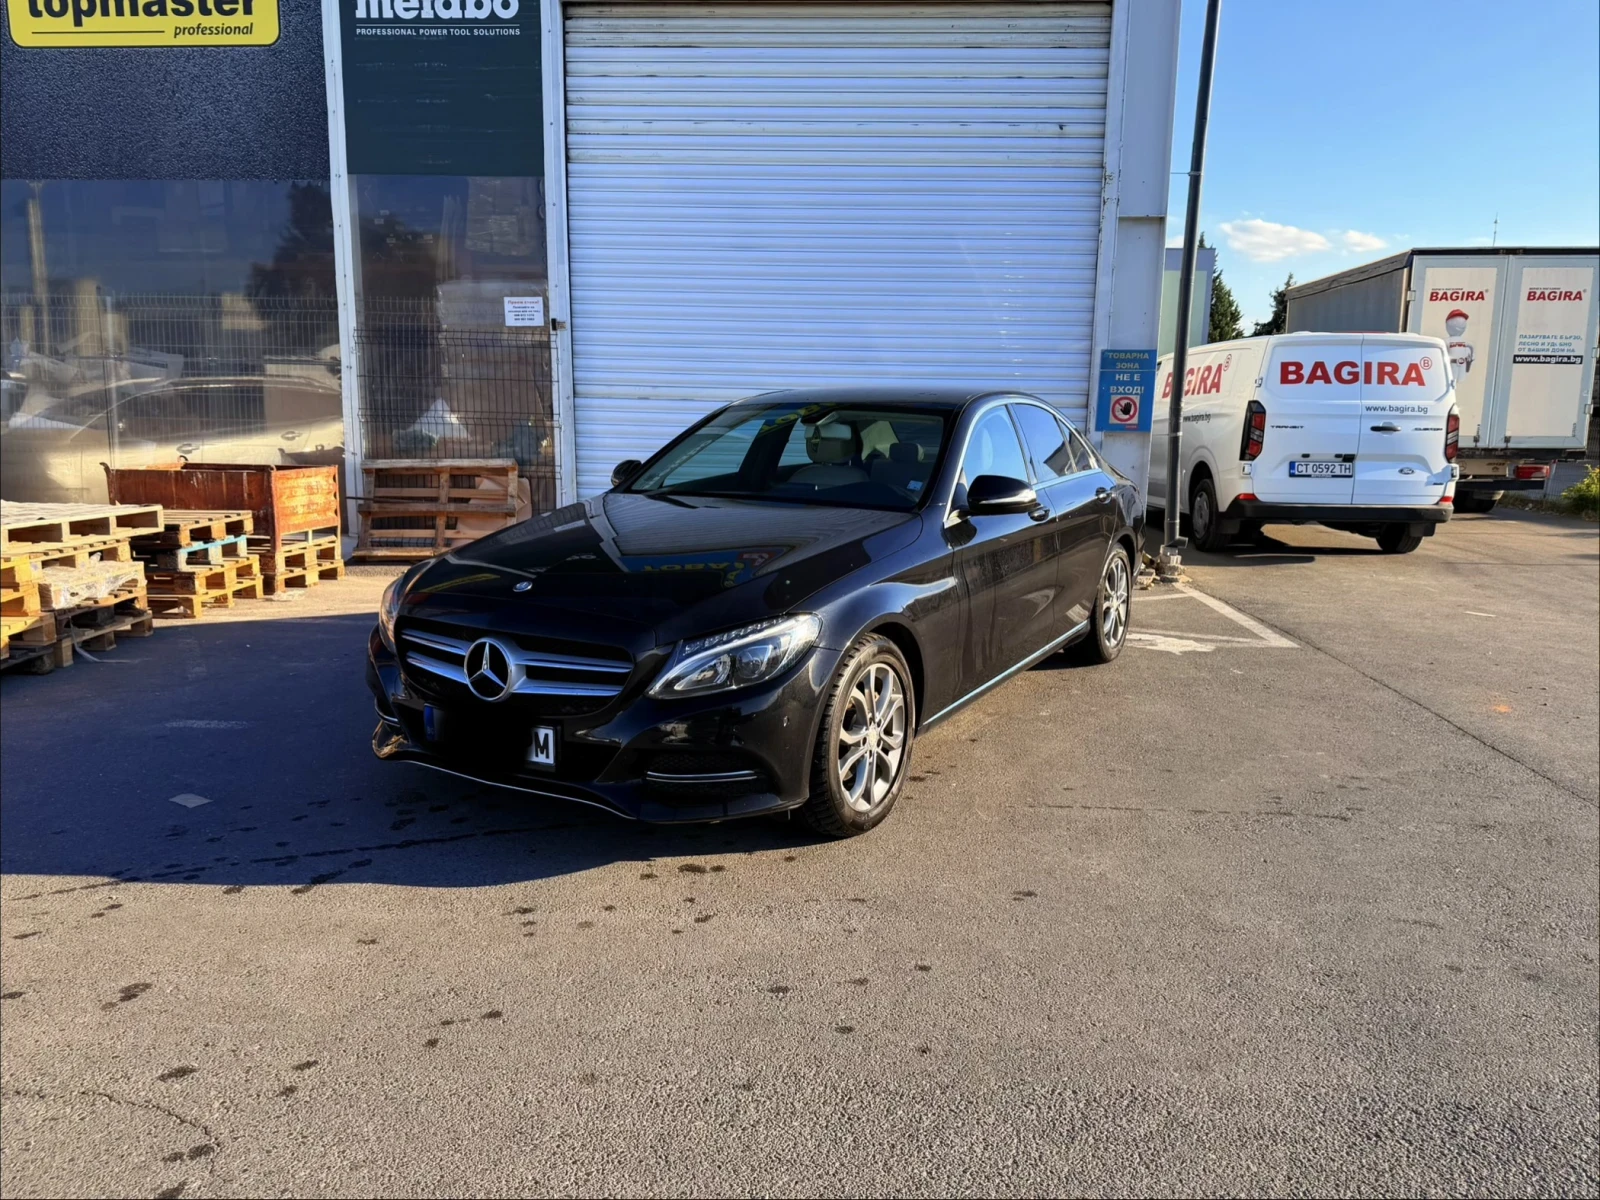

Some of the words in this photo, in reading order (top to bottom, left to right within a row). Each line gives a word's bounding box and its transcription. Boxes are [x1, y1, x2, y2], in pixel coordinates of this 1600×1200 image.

[174, 22, 253, 38] professional
[1429, 291, 1485, 301] BAGIRA
[1526, 291, 1583, 301] BAGIRA
[1515, 356, 1581, 364] www.bagira.bg
[1280, 361, 1426, 386] BAGIRA
[1162, 363, 1222, 398] BGIRA
[1110, 386, 1144, 394] ВХОД!
[1365, 404, 1428, 414] www.bagira.bg
[1297, 464, 1309, 473] CT
[1312, 464, 1336, 473] 0592
[1338, 464, 1351, 473] TH
[534, 731, 550, 759] M
